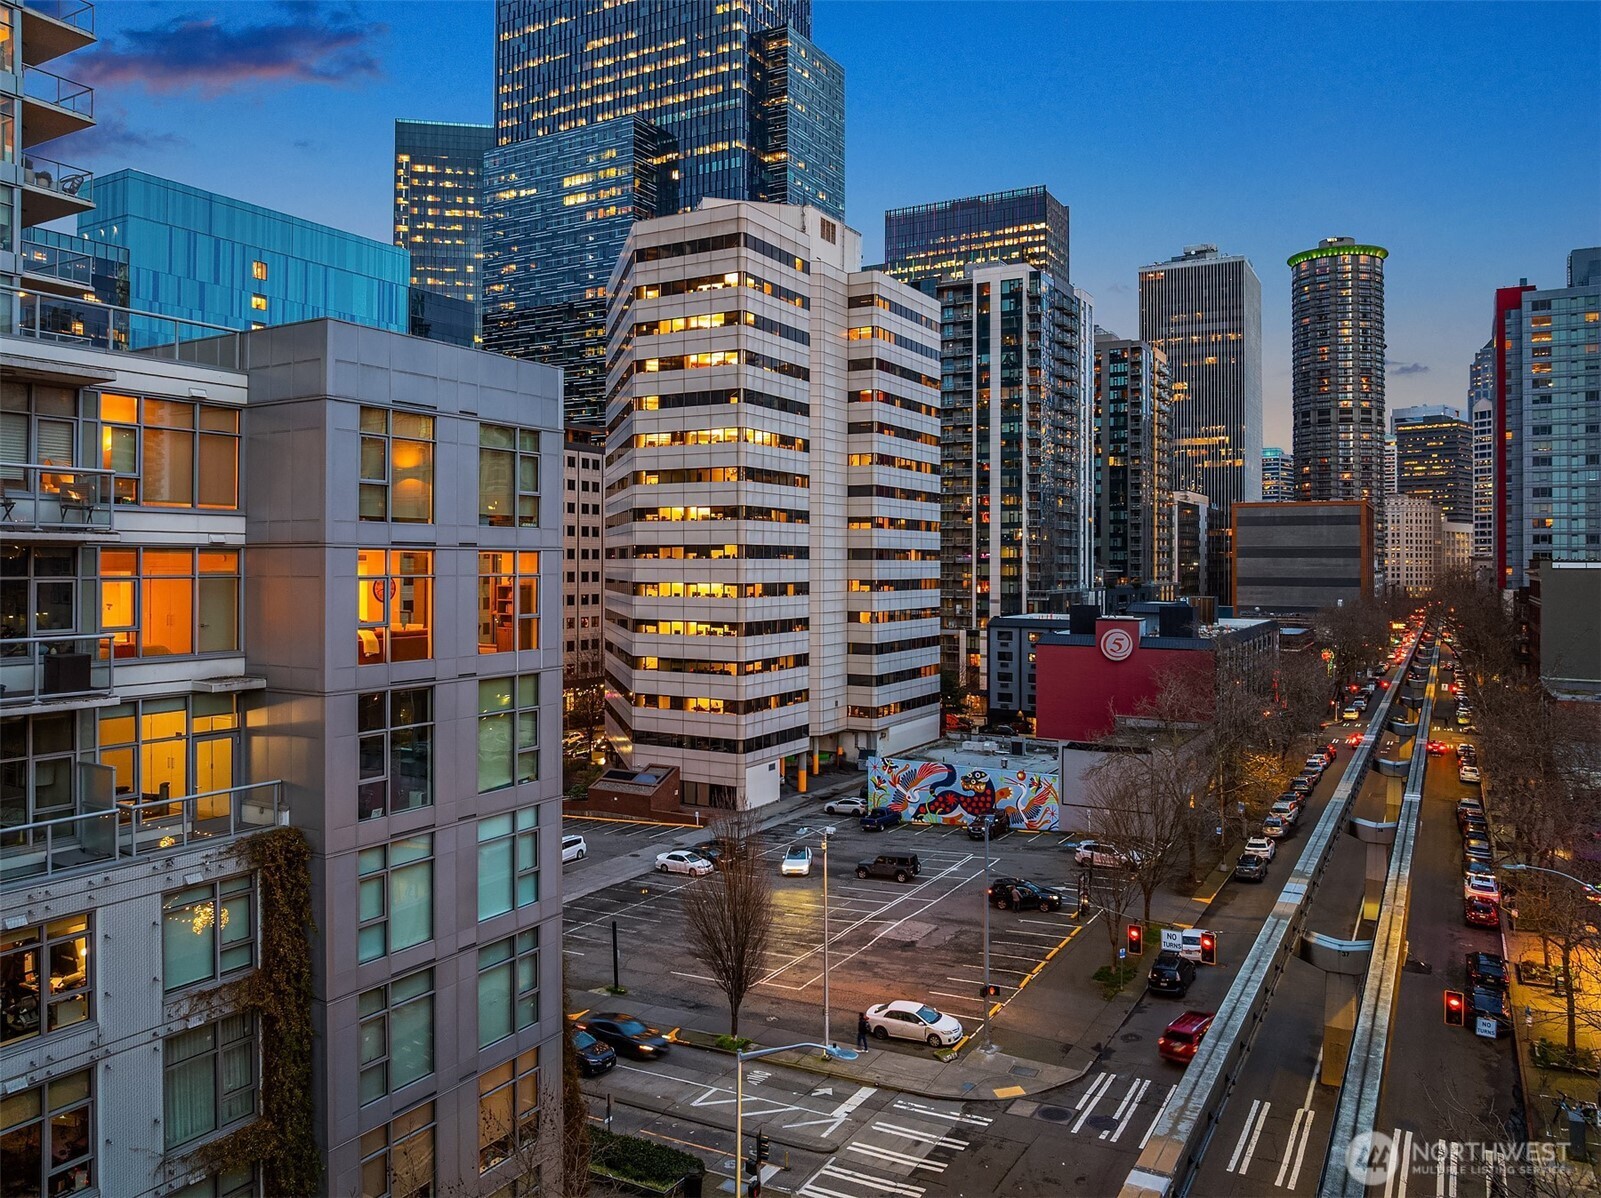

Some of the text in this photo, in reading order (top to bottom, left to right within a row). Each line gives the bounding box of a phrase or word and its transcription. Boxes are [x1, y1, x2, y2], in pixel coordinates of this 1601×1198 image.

[1166, 932, 1177, 941] NO
[1163, 941, 1182, 949] TURNS
[1477, 1028, 1496, 1036] TURNS
